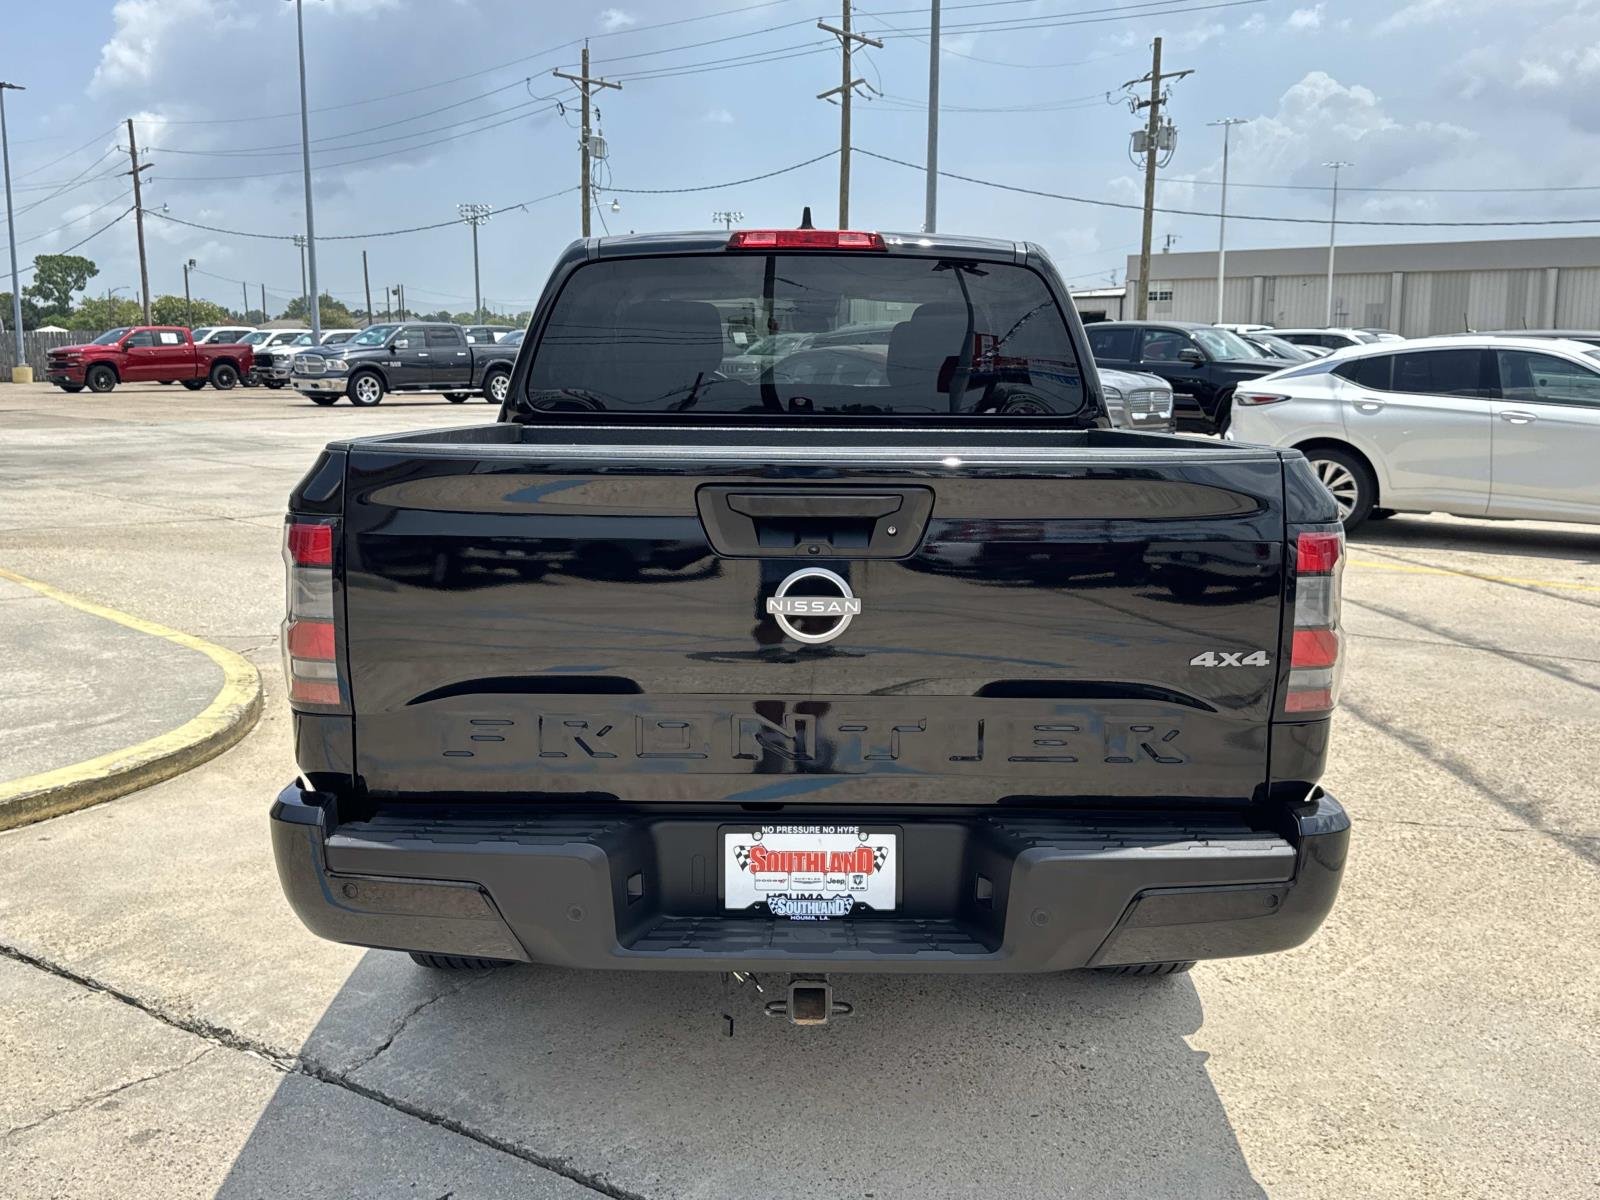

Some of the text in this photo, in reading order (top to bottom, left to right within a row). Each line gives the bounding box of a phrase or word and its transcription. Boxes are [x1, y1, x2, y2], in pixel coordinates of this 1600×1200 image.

[769, 600, 858, 612] NISSAN
[441, 711, 1190, 764] FRONTIER
[837, 826, 859, 834] HYPE
[749, 846, 874, 874] SOUTHLAND
[777, 900, 845, 914] SOUTHLAND
